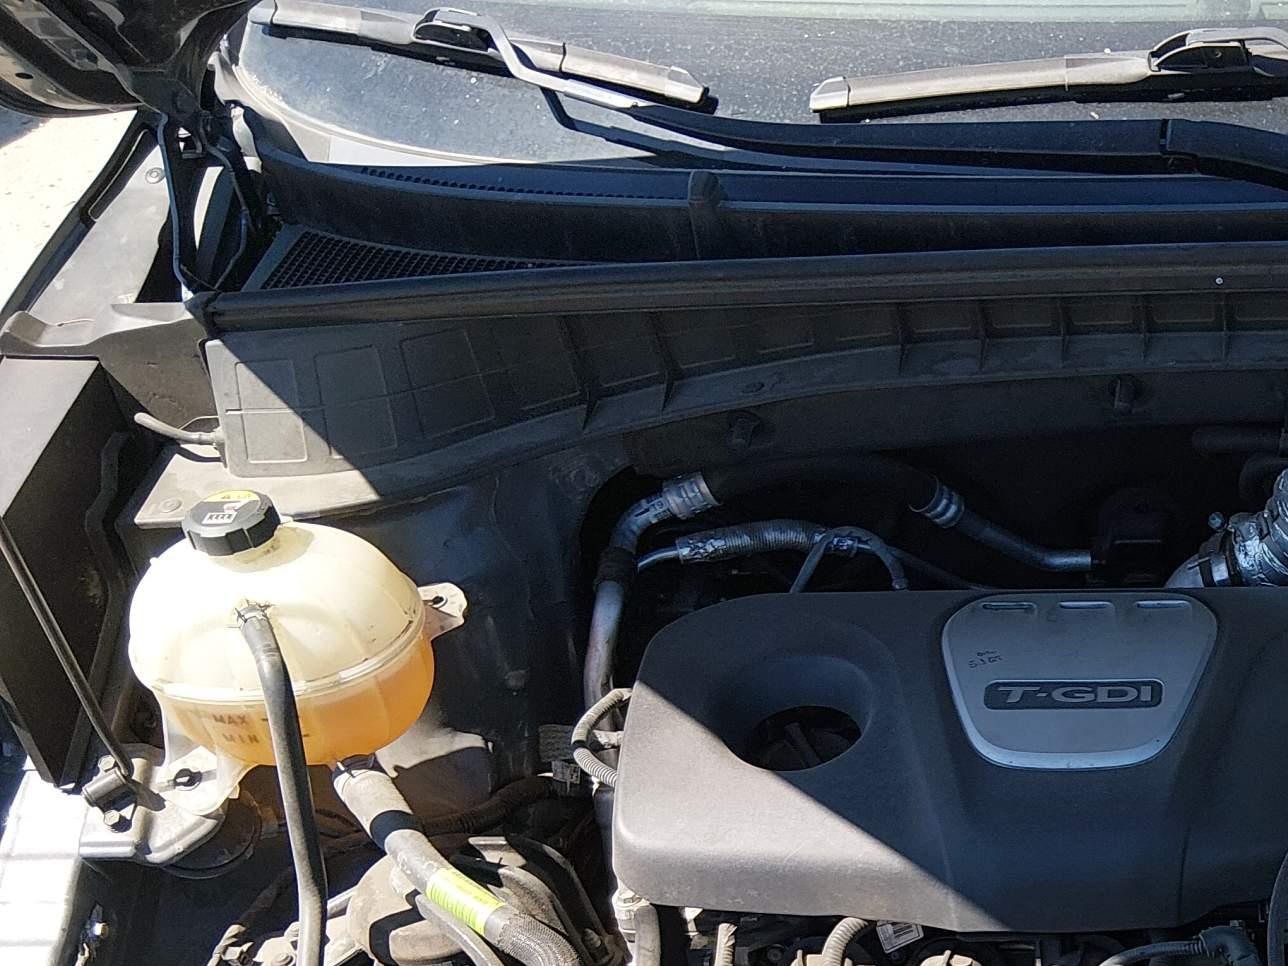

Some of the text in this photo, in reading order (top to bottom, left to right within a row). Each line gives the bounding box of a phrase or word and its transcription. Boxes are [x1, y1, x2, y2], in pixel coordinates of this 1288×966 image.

[997, 685, 1153, 704] T-GDI
[212, 713, 248, 726] MAX
[222, 732, 260, 744] MIN
